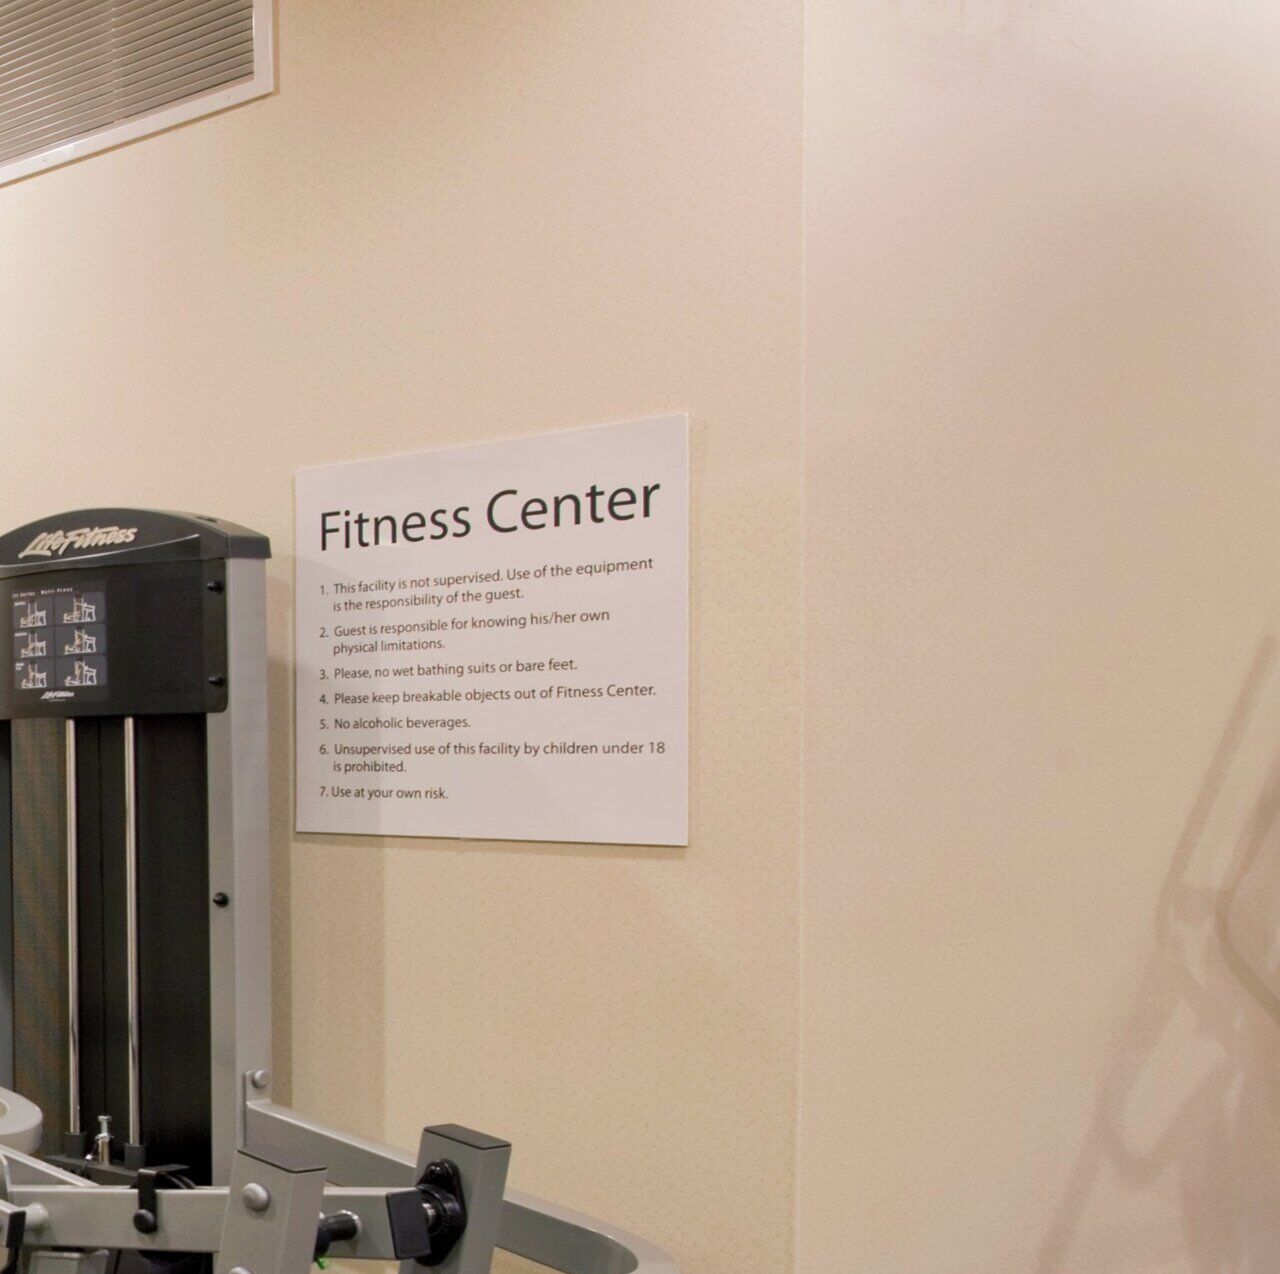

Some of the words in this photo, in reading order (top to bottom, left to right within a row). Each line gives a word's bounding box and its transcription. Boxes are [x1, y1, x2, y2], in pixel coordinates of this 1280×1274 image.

[321, 505, 471, 551] Fitness
[486, 483, 661, 533] Center
[320, 584, 329, 595] 1.
[334, 583, 356, 594] This
[358, 579, 395, 593] facility
[398, 578, 407, 589] is
[409, 577, 431, 588] not
[434, 569, 503, 587] supervised.
[506, 567, 531, 581] Use
[533, 565, 548, 579] of
[550, 564, 573, 576] the
[576, 557, 654, 576] equipment
[333, 601, 342, 612] is
[344, 599, 363, 611] the
[365, 594, 443, 612] responsibility
[445, 591, 458, 604] of
[461, 590, 483, 602] the
[485, 589, 525, 604] guest.
[319, 626, 329, 638] 2.
[334, 625, 366, 637] Guest
[369, 624, 378, 635] is
[380, 619, 448, 636] responsible
[451, 618, 468, 630] for
[471, 614, 527, 629] knowing
[530, 611, 577, 626] his/her
[580, 611, 611, 623] own
[333, 641, 378, 656] physical
[381, 637, 446, 652] limitations.
[319, 668, 329, 680] 3.
[334, 667, 372, 680] Please,
[375, 667, 390, 678] no
[392, 666, 415, 677] wet
[417, 663, 465, 678] bathing
[468, 661, 497, 674] suits
[499, 663, 513, 673] or
[515, 660, 545, 673] bare
[548, 657, 579, 671] feet.
[319, 693, 329, 705] 4.
[334, 692, 369, 704] Please
[372, 691, 400, 706] keep
[402, 689, 462, 703] breakable
[465, 688, 512, 704] objects
[514, 689, 536, 700] out
[539, 686, 553, 699] of
[556, 685, 604, 699] Fitness
[606, 683, 657, 698] Center.
[319, 718, 330, 730] 5.
[334, 718, 351, 730] No
[352, 716, 405, 730] alcoholic
[406, 716, 471, 731] beverages.
[319, 743, 329, 756] 6.
[334, 743, 412, 758] Unsupervised
[414, 745, 435, 756] use
[437, 742, 452, 755] of
[453, 742, 476, 755] this
[478, 741, 521, 758] facility
[523, 741, 540, 757] by
[542, 741, 599, 755] children
[602, 741, 645, 755] under
[648, 741, 666, 755] 18
[333, 761, 342, 773] is
[344, 760, 407, 775] prohibited.
[319, 786, 329, 798] 7.
[331, 785, 352, 798] Use
[354, 786, 365, 798] at
[367, 788, 394, 801] your
[396, 789, 422, 799] own
[424, 786, 449, 800] risk.
